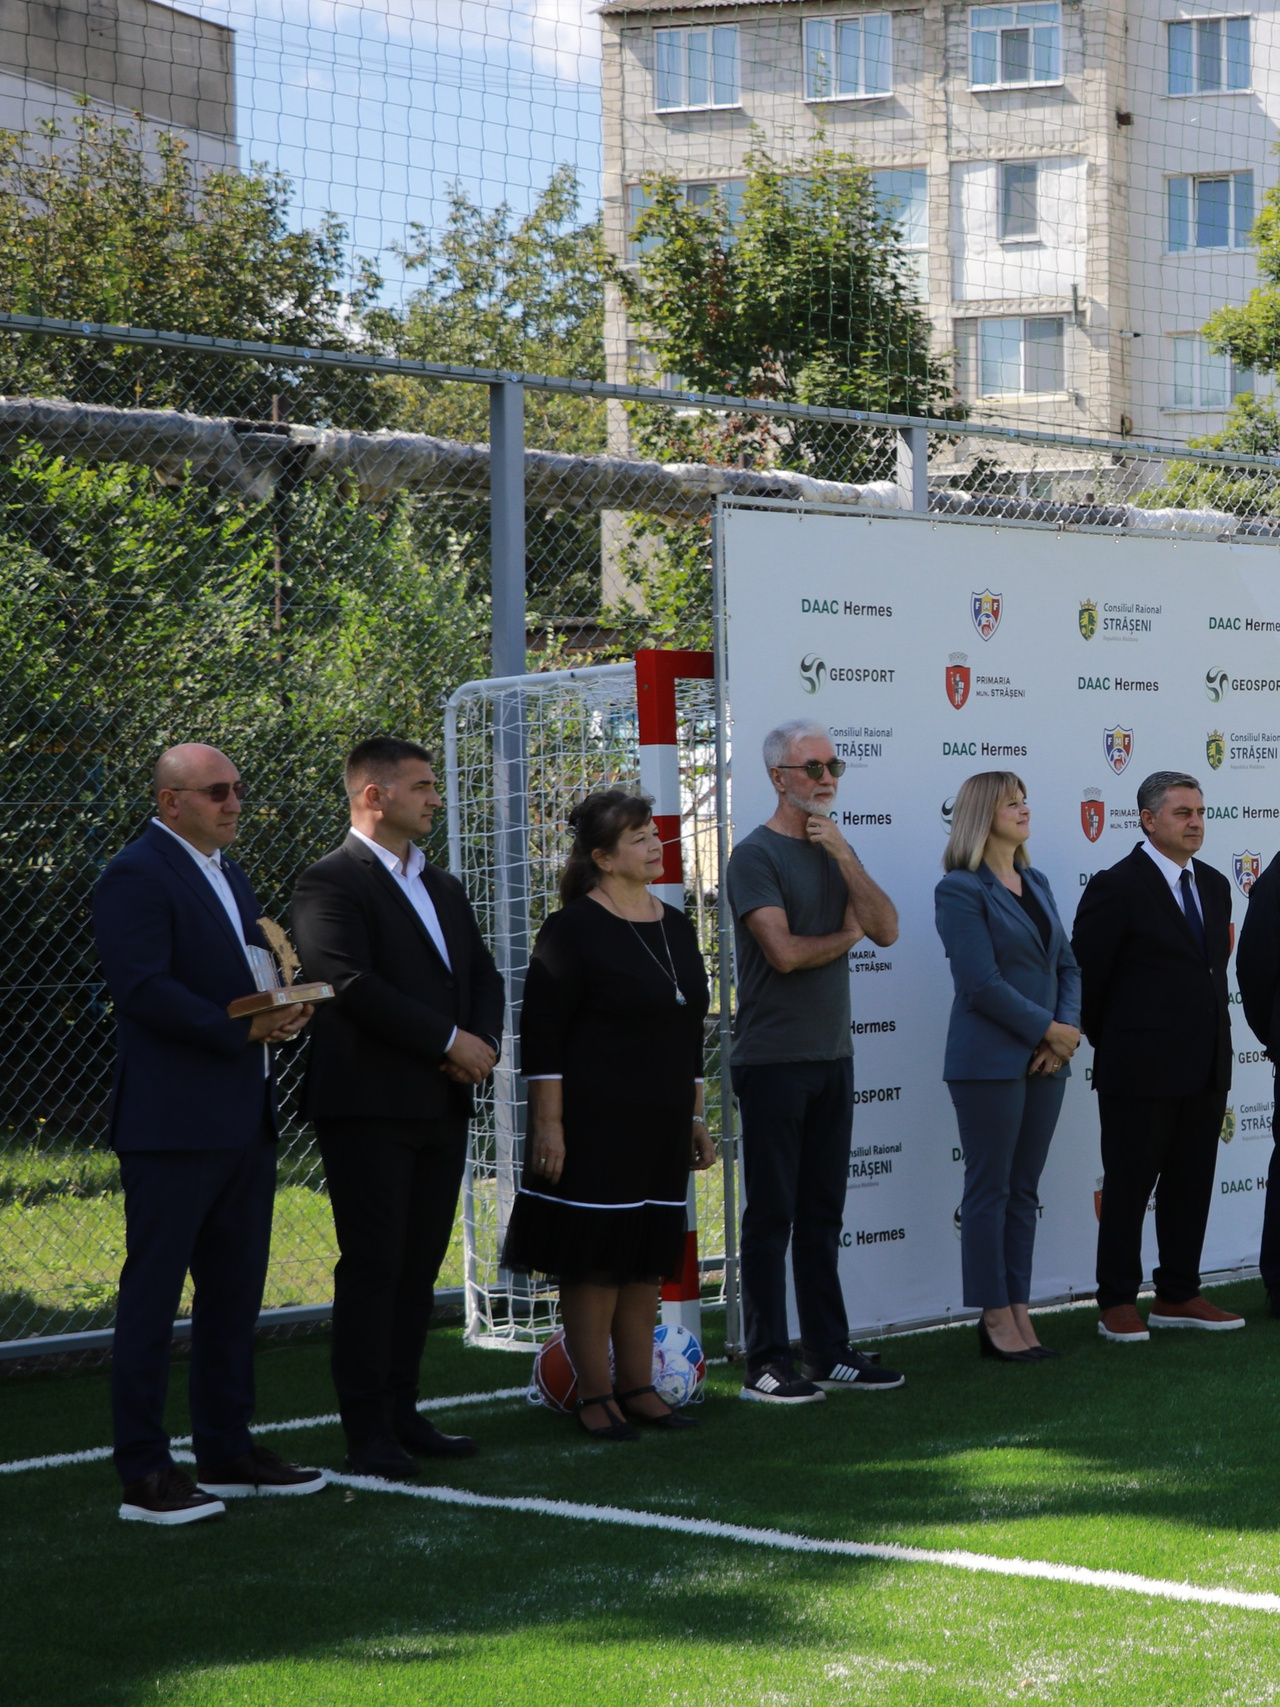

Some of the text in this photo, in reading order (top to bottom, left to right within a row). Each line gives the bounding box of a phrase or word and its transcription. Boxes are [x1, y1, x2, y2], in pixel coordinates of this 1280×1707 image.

[801, 599, 893, 617] DAAC Hermes
[1103, 602, 1162, 614] Consiliul Raional
[1208, 617, 1241, 630] DAAC
[829, 667, 895, 683] GEOSPORT
[976, 676, 1011, 684] PRIMARIA
[1077, 676, 1159, 692] DAAC Hermes
[829, 726, 893, 737] Consiliul Raional
[1230, 732, 1260, 742] Consiliul
[834, 740, 882, 761] TRĂȘENI
[942, 742, 1028, 757] DAAC Hermes
[842, 811, 892, 825] Hermes
[1206, 806, 1239, 819] DAAC
[849, 950, 877, 960] IMARIA
[853, 1087, 902, 1105] OSPORT
[1240, 1101, 1270, 1114] Consiliul
[1241, 1113, 1273, 1132] STRĂȘ
[850, 1142, 902, 1158] nsiliul Raional
[847, 1160, 892, 1180] TRĂȘENI
[1221, 1178, 1253, 1195] DAAC
[856, 1227, 906, 1246] Hermes
